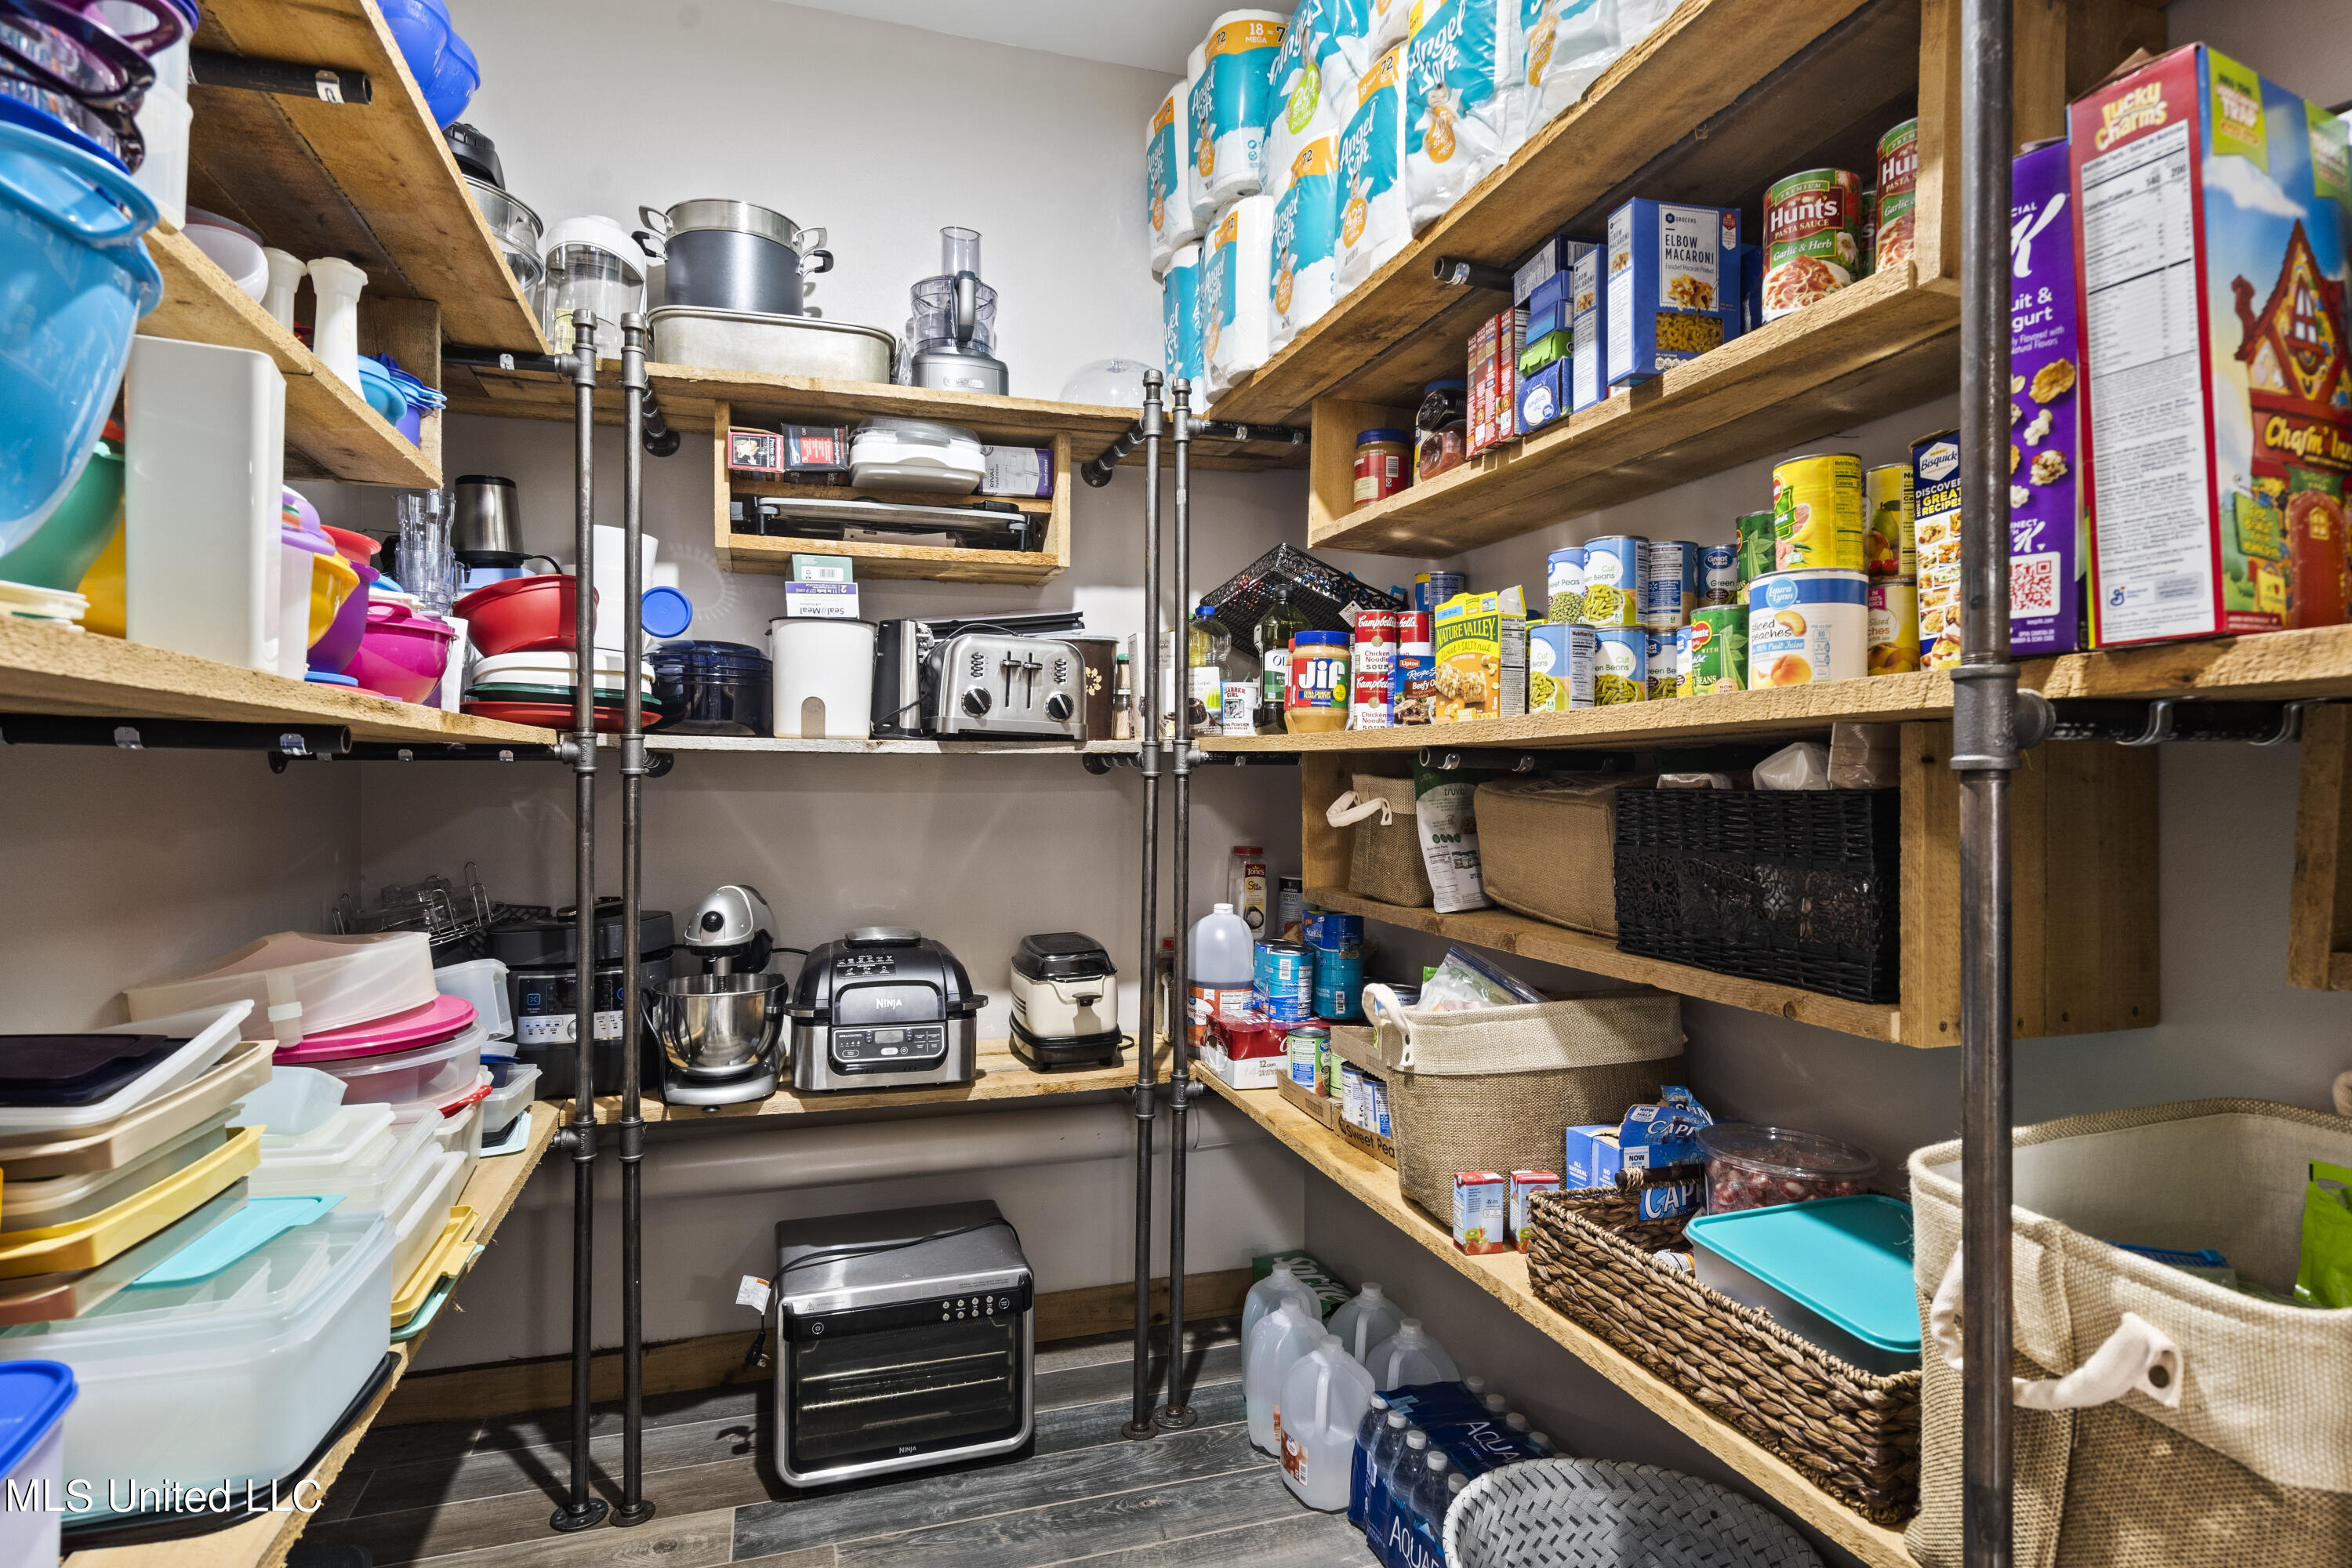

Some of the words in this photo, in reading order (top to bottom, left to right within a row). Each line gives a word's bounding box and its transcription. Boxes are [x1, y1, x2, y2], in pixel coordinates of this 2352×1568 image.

[1250, 23, 1264, 36] 18
[1411, 0, 1466, 74] Angel
[1216, 31, 1226, 45] 72
[1245, 36, 1268, 45] MEGA
[1380, 55, 1394, 75] 72
[1191, 64, 1216, 117] Angel
[2102, 81, 2162, 125] Lucky
[1196, 96, 1215, 130] Soft
[2094, 100, 2169, 151] Charms
[1338, 100, 1377, 173] Angel
[1892, 132, 1916, 149] PREM
[1146, 132, 1165, 172] Angel
[1301, 149, 1313, 165] 72
[1780, 182, 1822, 199] PREMIUM
[1885, 176, 1909, 193] PASTA
[1884, 198, 1910, 217] Garlic
[1225, 216, 1235, 230] 72
[1271, 187, 1300, 245] Angel
[1675, 216, 1697, 225] GROCERS
[1770, 198, 1838, 233] Hunt's
[1610, 228, 1622, 242] ELBOW
[1773, 225, 1798, 240] PASTA
[1799, 219, 1830, 230] SAUCE
[1610, 231, 1630, 250] MACARONI
[1665, 234, 1698, 249] ELBOW
[1665, 248, 1715, 265] MACARONI
[1773, 244, 1797, 261] Garlic
[1798, 243, 1806, 252] &
[1808, 239, 1832, 251] Herb
[1203, 250, 1225, 297] Angel
[1700, 266, 1715, 274] Product
[2037, 286, 2053, 305] &
[1501, 310, 1512, 321] RICE
[2011, 306, 2053, 333] gurt
[1485, 318, 1496, 329] RICE
[1476, 326, 1486, 337] RICE
[1468, 336, 1477, 347] RICE
[2034, 336, 2059, 349] Flavors
[1921, 451, 1958, 471] Bisquick
[1602, 564, 1615, 572] Cut
[1593, 572, 1616, 581] Beans
[1710, 579, 1735, 587] Green
[840, 584, 848, 593] 2
[1768, 584, 1792, 595] Laura
[1772, 593, 1794, 604] Lynn
[1358, 615, 1396, 629] Campbell's
[1751, 619, 1775, 633] sliced
[1436, 622, 1464, 651] NATURE
[1463, 617, 1496, 641] VALLEY
[1751, 629, 1792, 644] peaches
[1461, 641, 1477, 652] SALTY
[1477, 644, 1492, 652] nut
[1615, 655, 1629, 664] Cut
[1298, 660, 1345, 689] Jif
[1696, 675, 1717, 685] BEANS
[1412, 681, 1430, 691] Beefy
[1306, 927, 1323, 938] StarKist
[876, 996, 903, 1011] NINJA
[1345, 1124, 1374, 1149] Sweet
[1377, 1138, 1396, 1159] Pea
[1568, 1164, 1588, 1178] NATURAL
[1602, 1167, 1611, 1176] NO
[898, 1445, 917, 1455] NINJA
